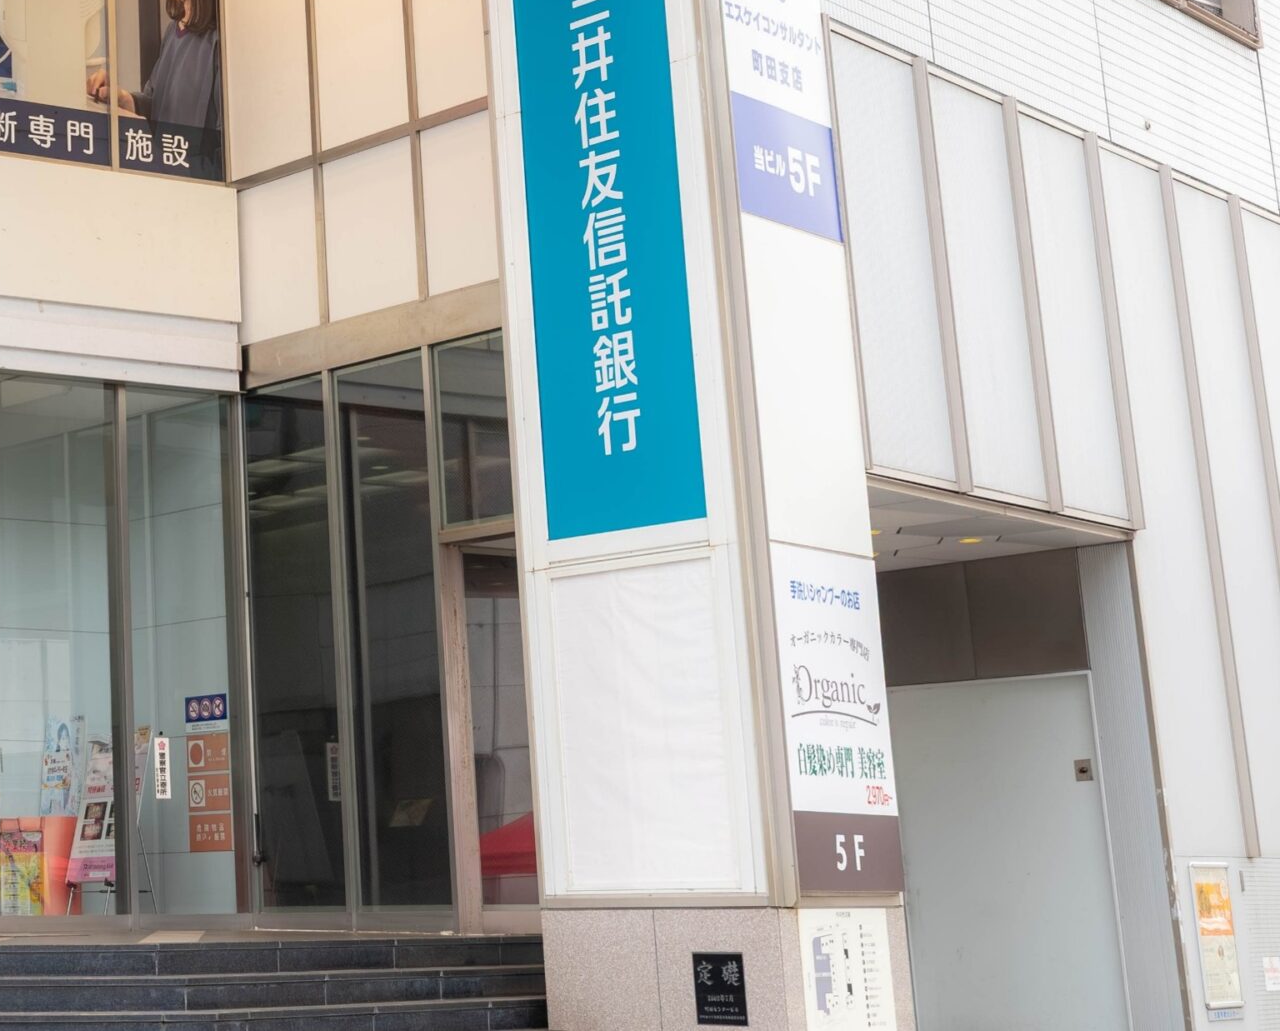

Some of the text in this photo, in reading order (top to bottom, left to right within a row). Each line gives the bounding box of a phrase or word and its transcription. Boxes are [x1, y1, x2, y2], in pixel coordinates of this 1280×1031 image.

[724, 0, 822, 56] エスケイコンサルタント
[751, 49, 803, 93] 町田支店
[793, 664, 867, 709] Organic
[858, 749, 887, 780] 美容室
